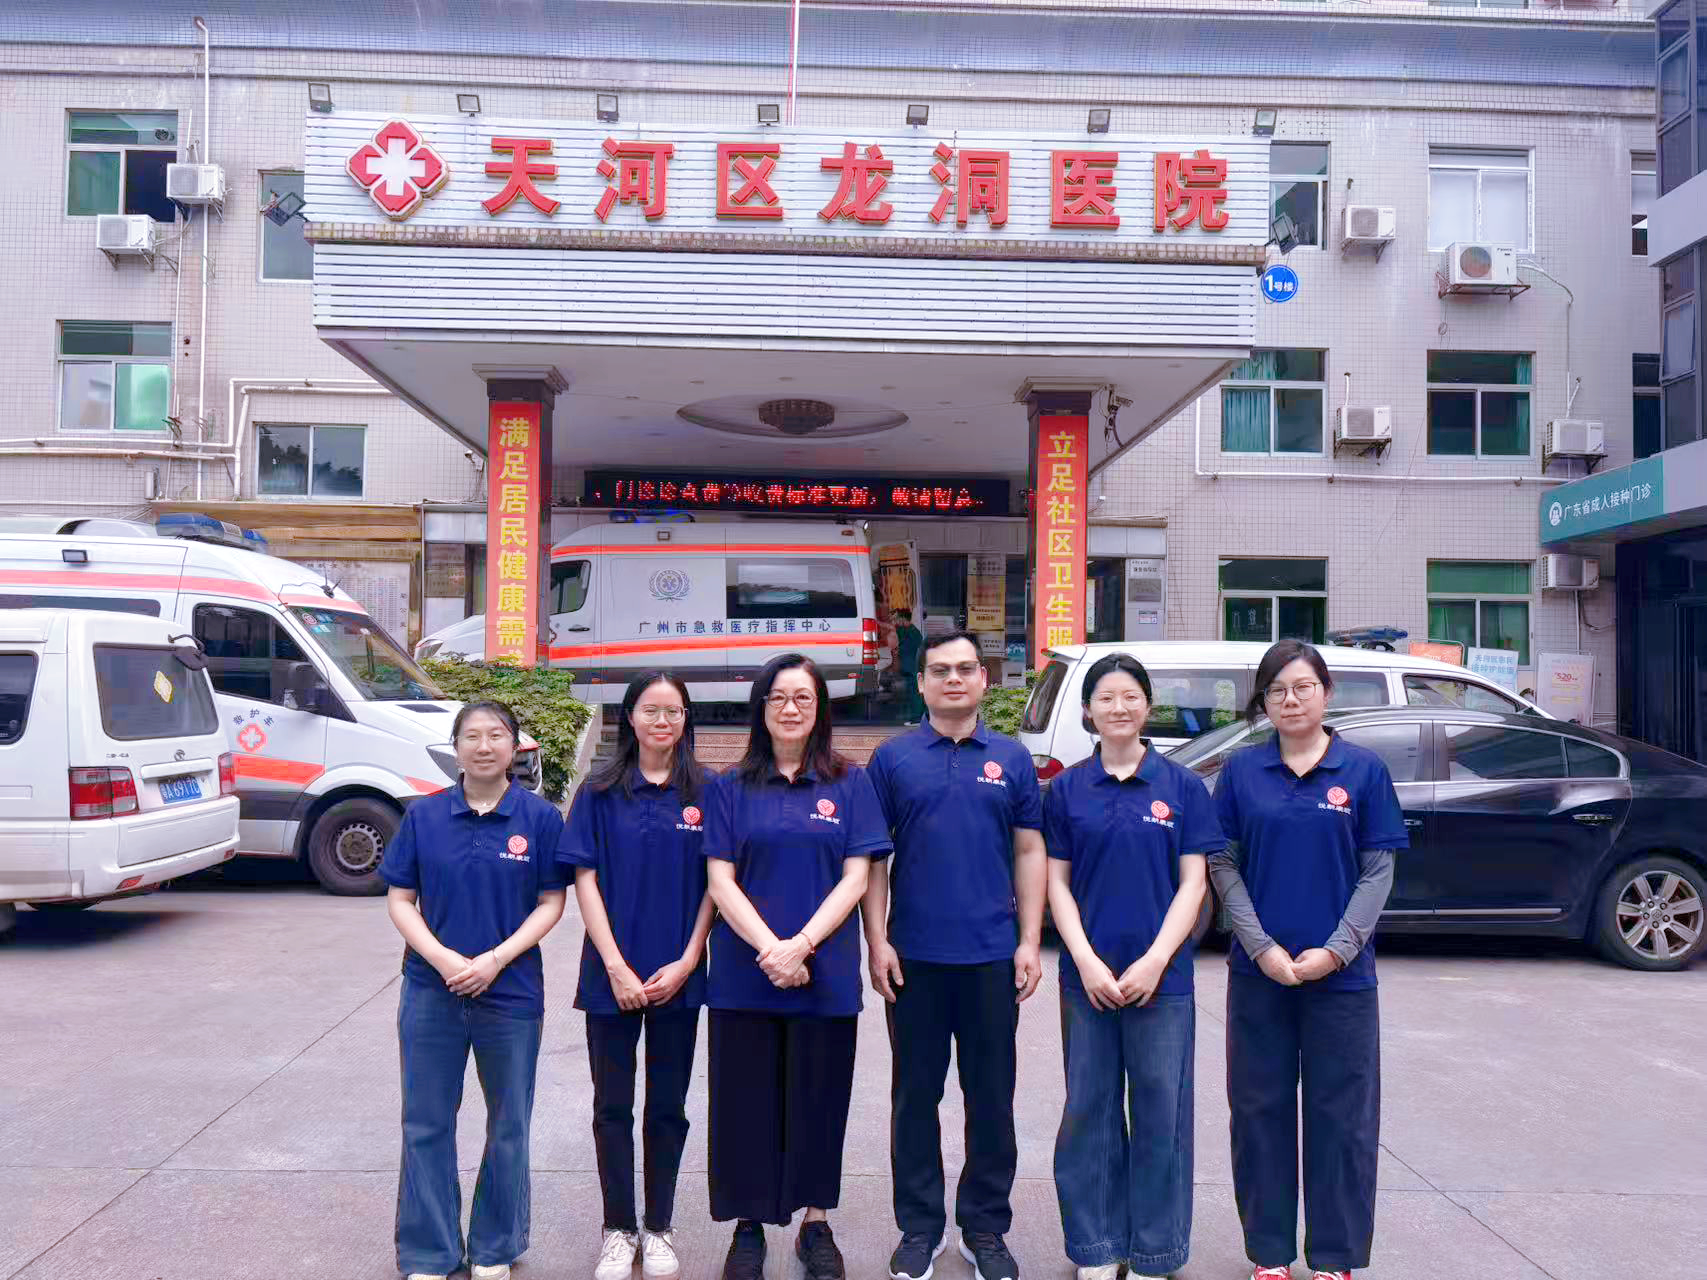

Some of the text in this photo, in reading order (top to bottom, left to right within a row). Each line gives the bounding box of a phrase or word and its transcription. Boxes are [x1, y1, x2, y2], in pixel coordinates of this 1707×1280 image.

[481, 137, 1229, 232] 天河区龙洞医院
[1265, 274, 1294, 292] 1号楼
[1563, 483, 1652, 520] 广东省成人接种门诊
[1046, 431, 1076, 647] 立足社区卫生服
[638, 619, 832, 634] 广州市急救医疗指挥中心
[233, 708, 275, 727] 救护车
